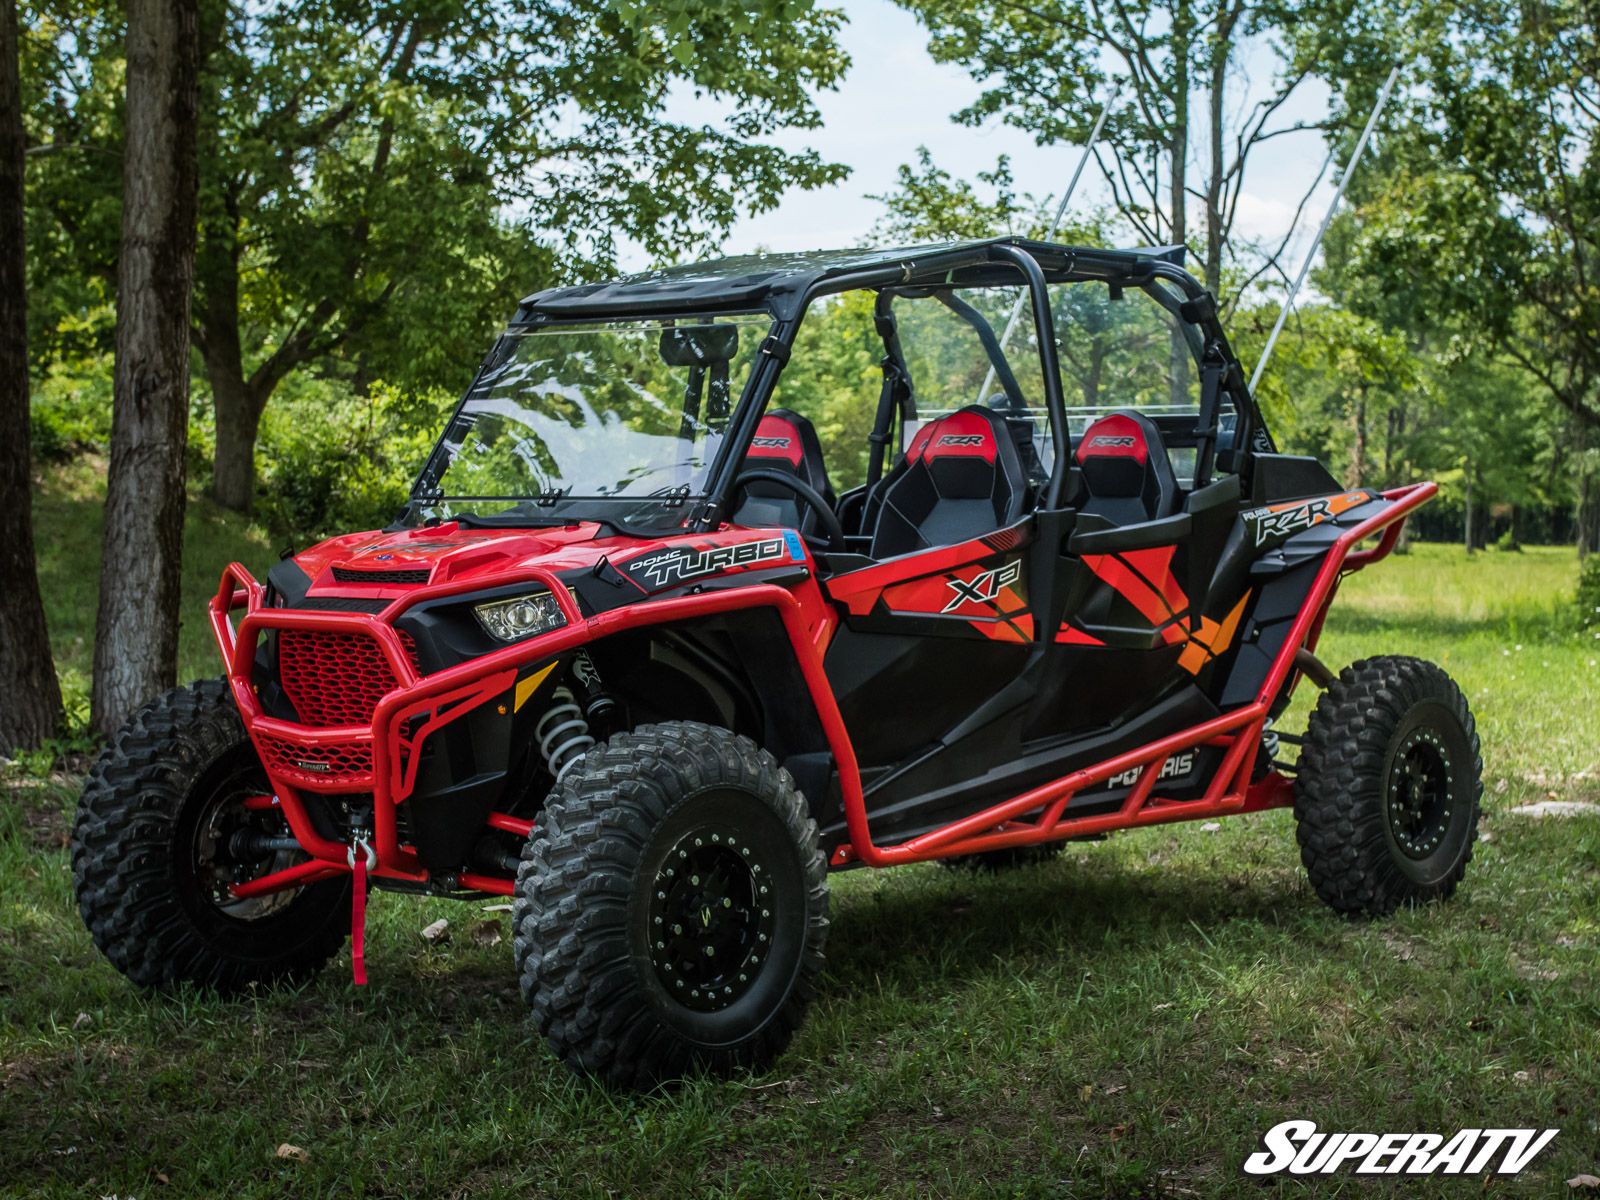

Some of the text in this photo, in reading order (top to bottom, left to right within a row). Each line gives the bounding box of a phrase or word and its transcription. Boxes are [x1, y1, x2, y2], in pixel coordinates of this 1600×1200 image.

[936, 435, 984, 447] RZR
[1088, 436, 1136, 447] RZR
[1256, 498, 1335, 547] RZR
[629, 550, 681, 571] DOHC
[644, 537, 784, 586] TURBO
[940, 559, 1021, 613] XP
[1107, 753, 1193, 789] POARIS
